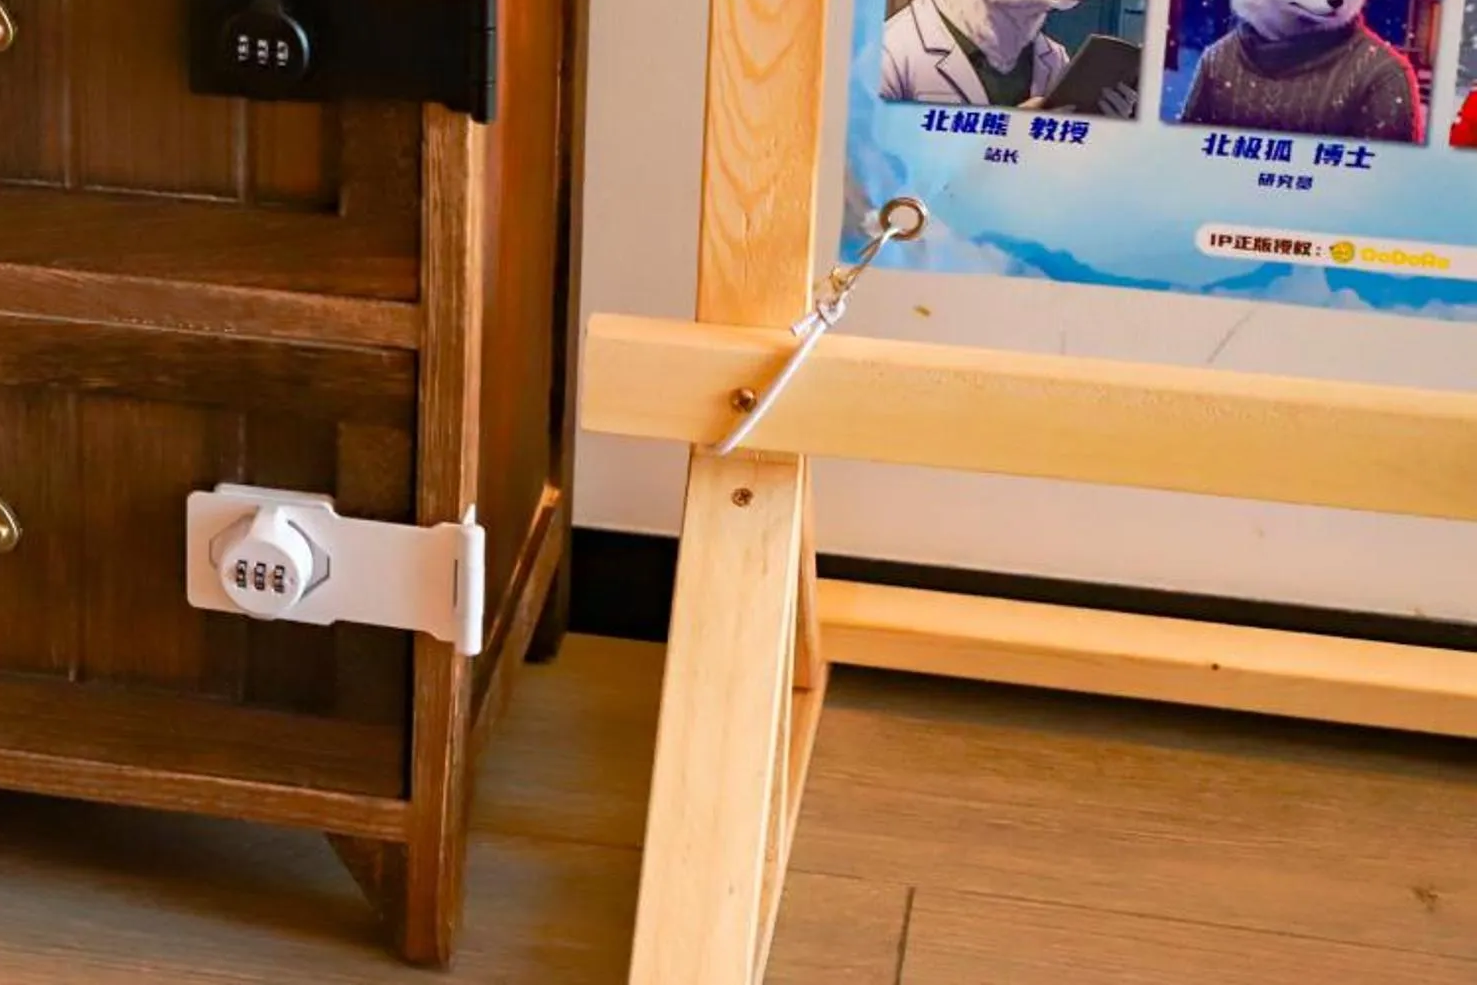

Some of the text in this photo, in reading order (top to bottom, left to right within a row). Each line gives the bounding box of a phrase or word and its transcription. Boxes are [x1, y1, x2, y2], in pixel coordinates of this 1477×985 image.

[920, 109, 1090, 144] 北极熊 教授
[984, 147, 1020, 164] 站长
[1201, 132, 1376, 169] 北极狐 博士
[1258, 172, 1314, 191] 研究员
